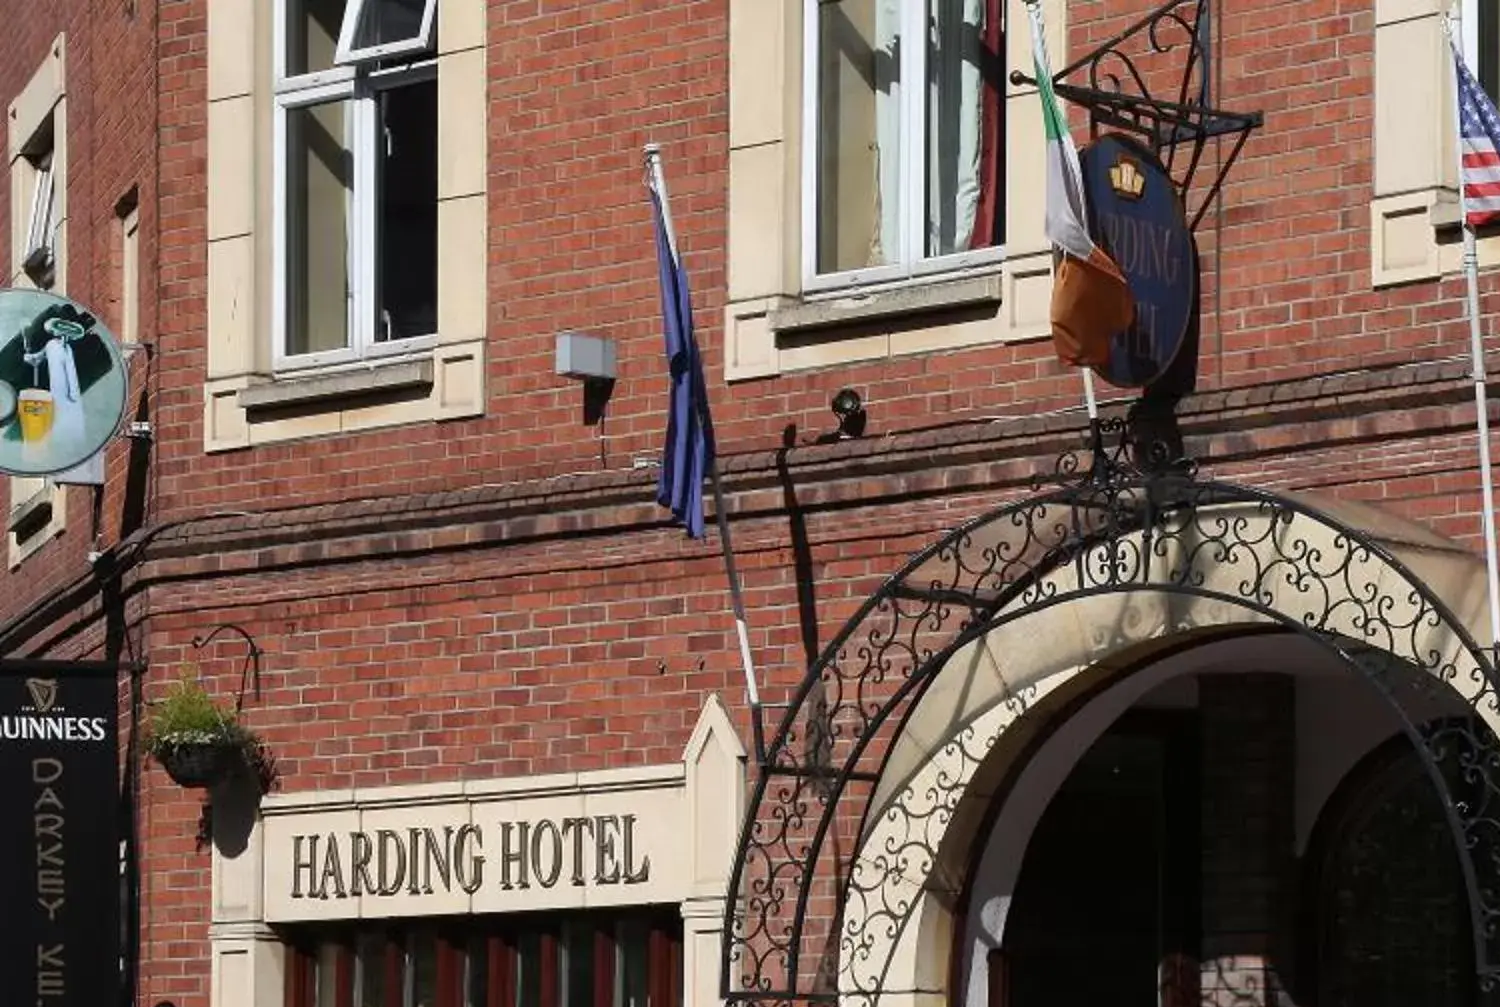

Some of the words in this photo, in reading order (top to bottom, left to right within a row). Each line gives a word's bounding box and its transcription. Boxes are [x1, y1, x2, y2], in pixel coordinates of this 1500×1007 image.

[0, 716, 106, 741] UINNESS
[31, 757, 65, 921] DARKEY
[290, 823, 486, 901] HARDING
[499, 813, 651, 891] HOTEL
